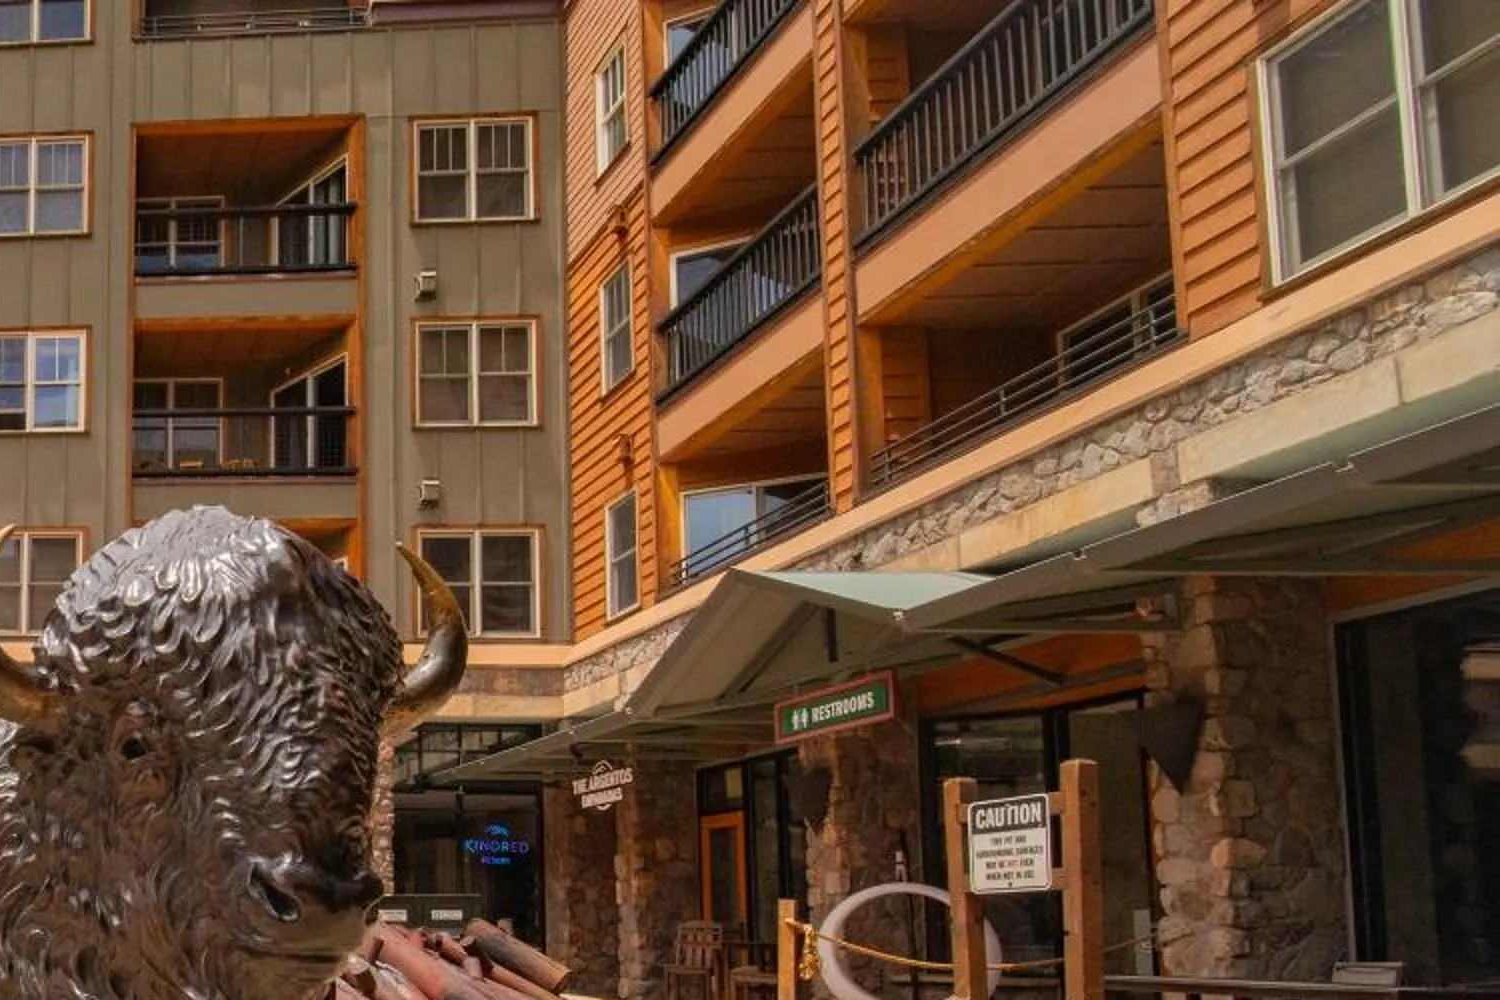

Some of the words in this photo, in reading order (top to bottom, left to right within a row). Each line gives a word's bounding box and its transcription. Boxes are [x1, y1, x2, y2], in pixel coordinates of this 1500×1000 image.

[811, 691, 875, 723] RESTROOMS
[975, 802, 1042, 829] CAUTION
[464, 839, 529, 853] KINDRED
